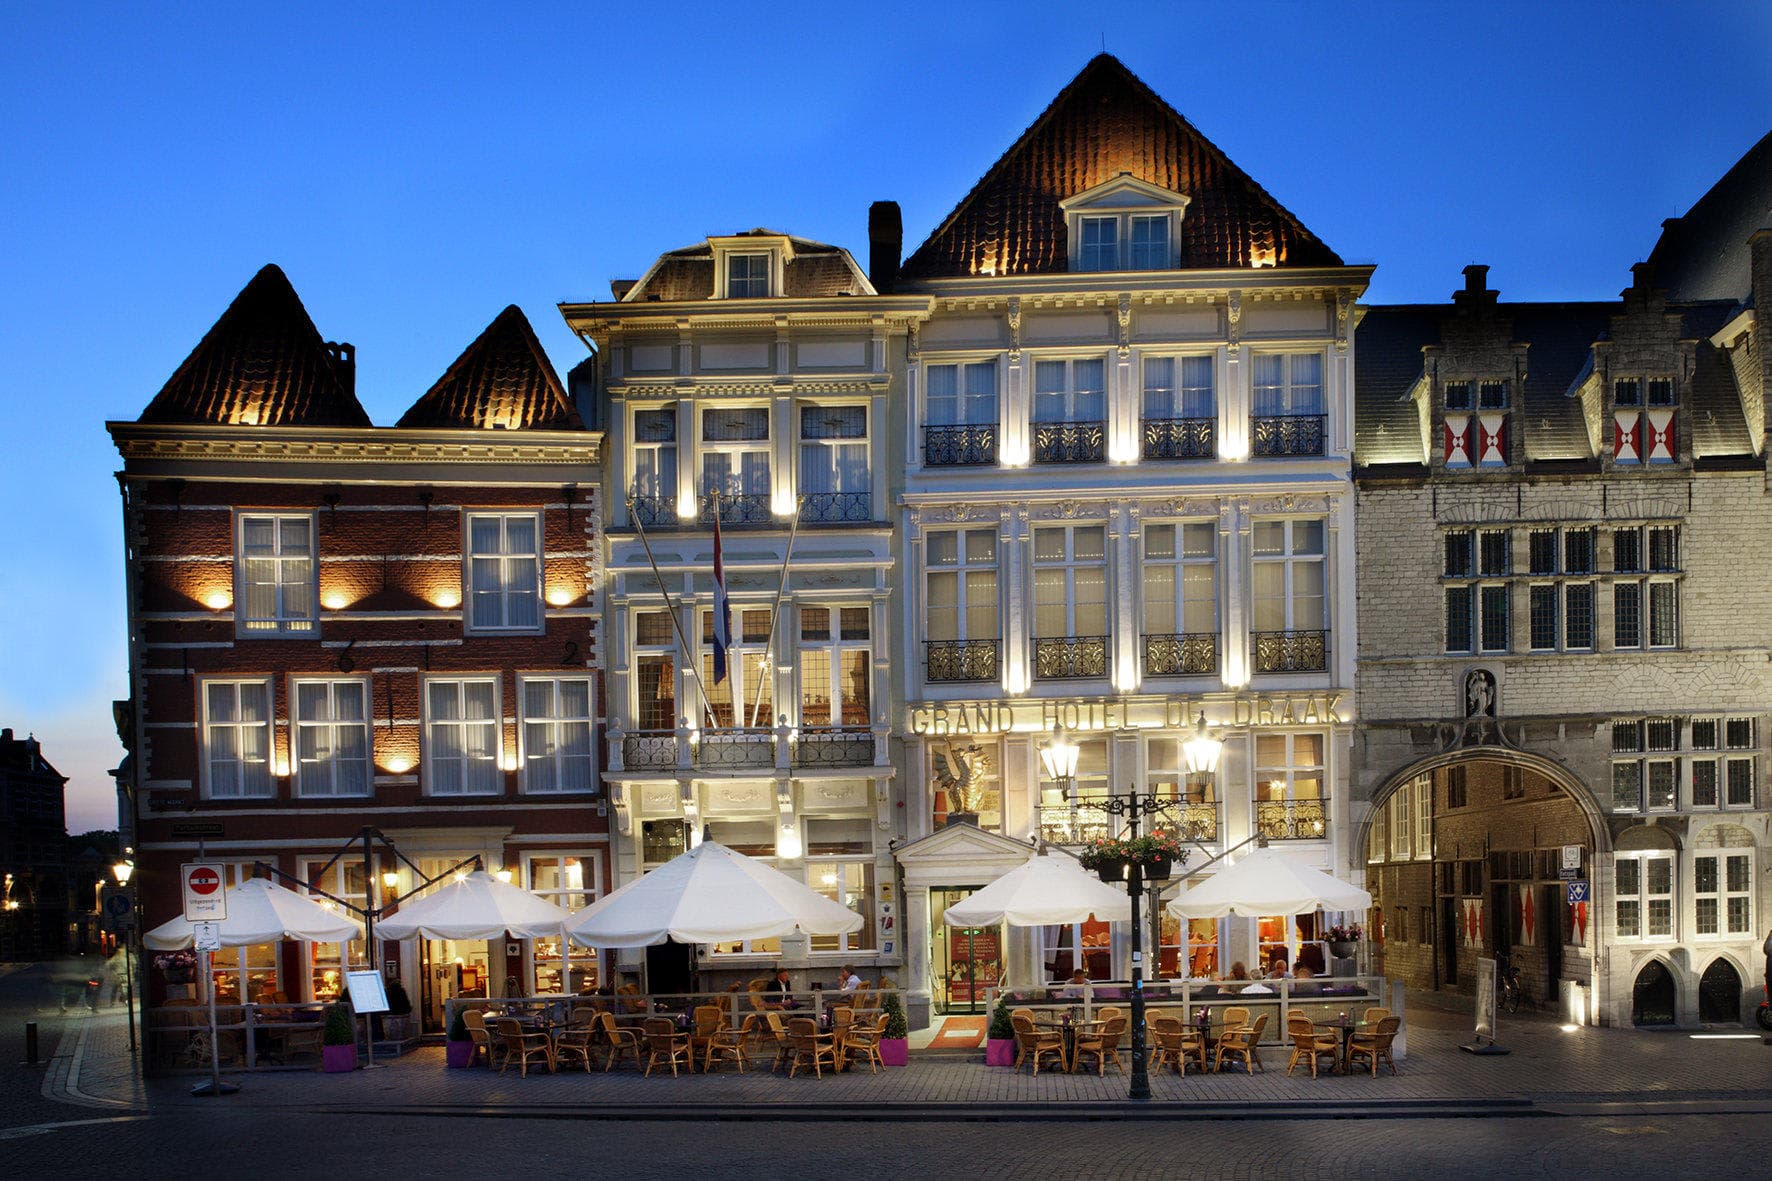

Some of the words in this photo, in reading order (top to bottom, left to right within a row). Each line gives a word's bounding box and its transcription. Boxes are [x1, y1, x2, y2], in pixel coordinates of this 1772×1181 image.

[911, 701, 1014, 735] GRAND
[1042, 699, 1139, 731] HOTEL
[1166, 697, 1202, 728] DE
[1234, 694, 1345, 727] DRAAK
